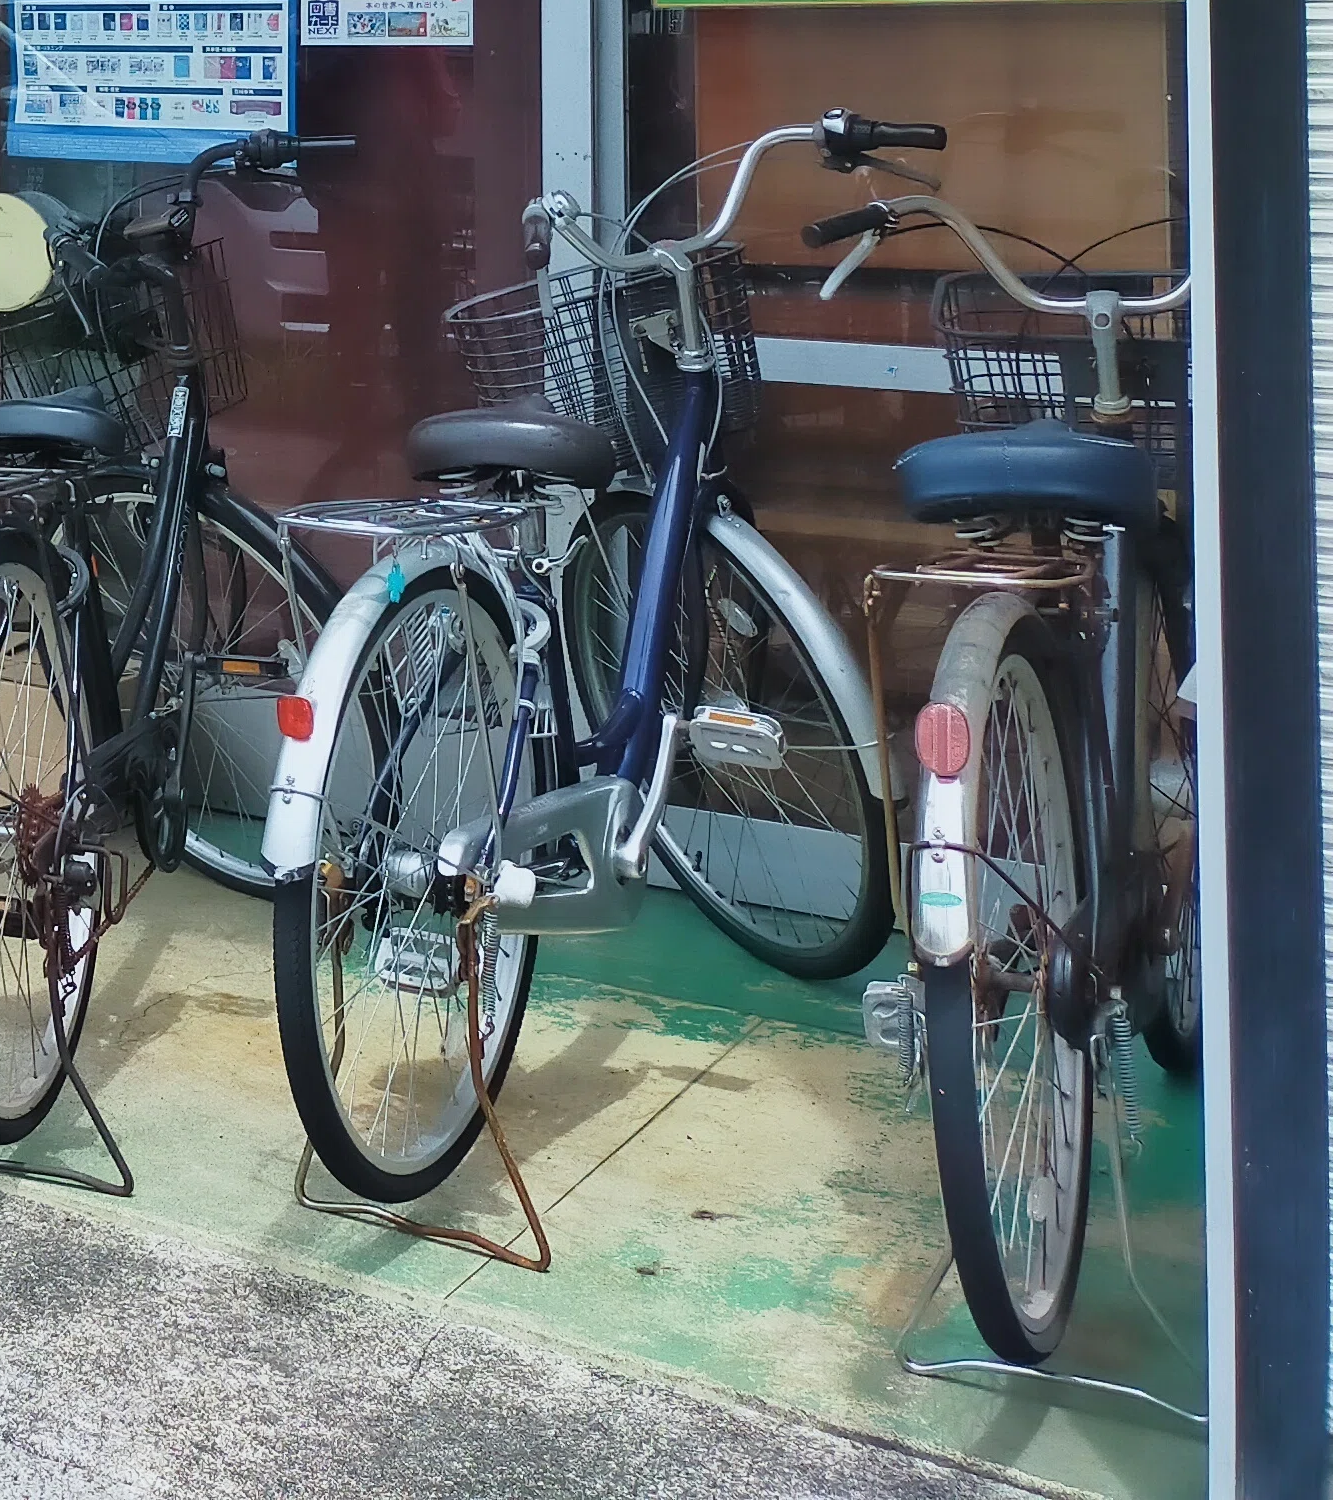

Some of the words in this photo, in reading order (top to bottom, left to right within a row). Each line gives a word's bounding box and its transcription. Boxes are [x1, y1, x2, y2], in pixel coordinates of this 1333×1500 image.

[309, 2, 338, 15] 図書
[309, 15, 338, 26] カード
[308, 27, 339, 35] NEXT
